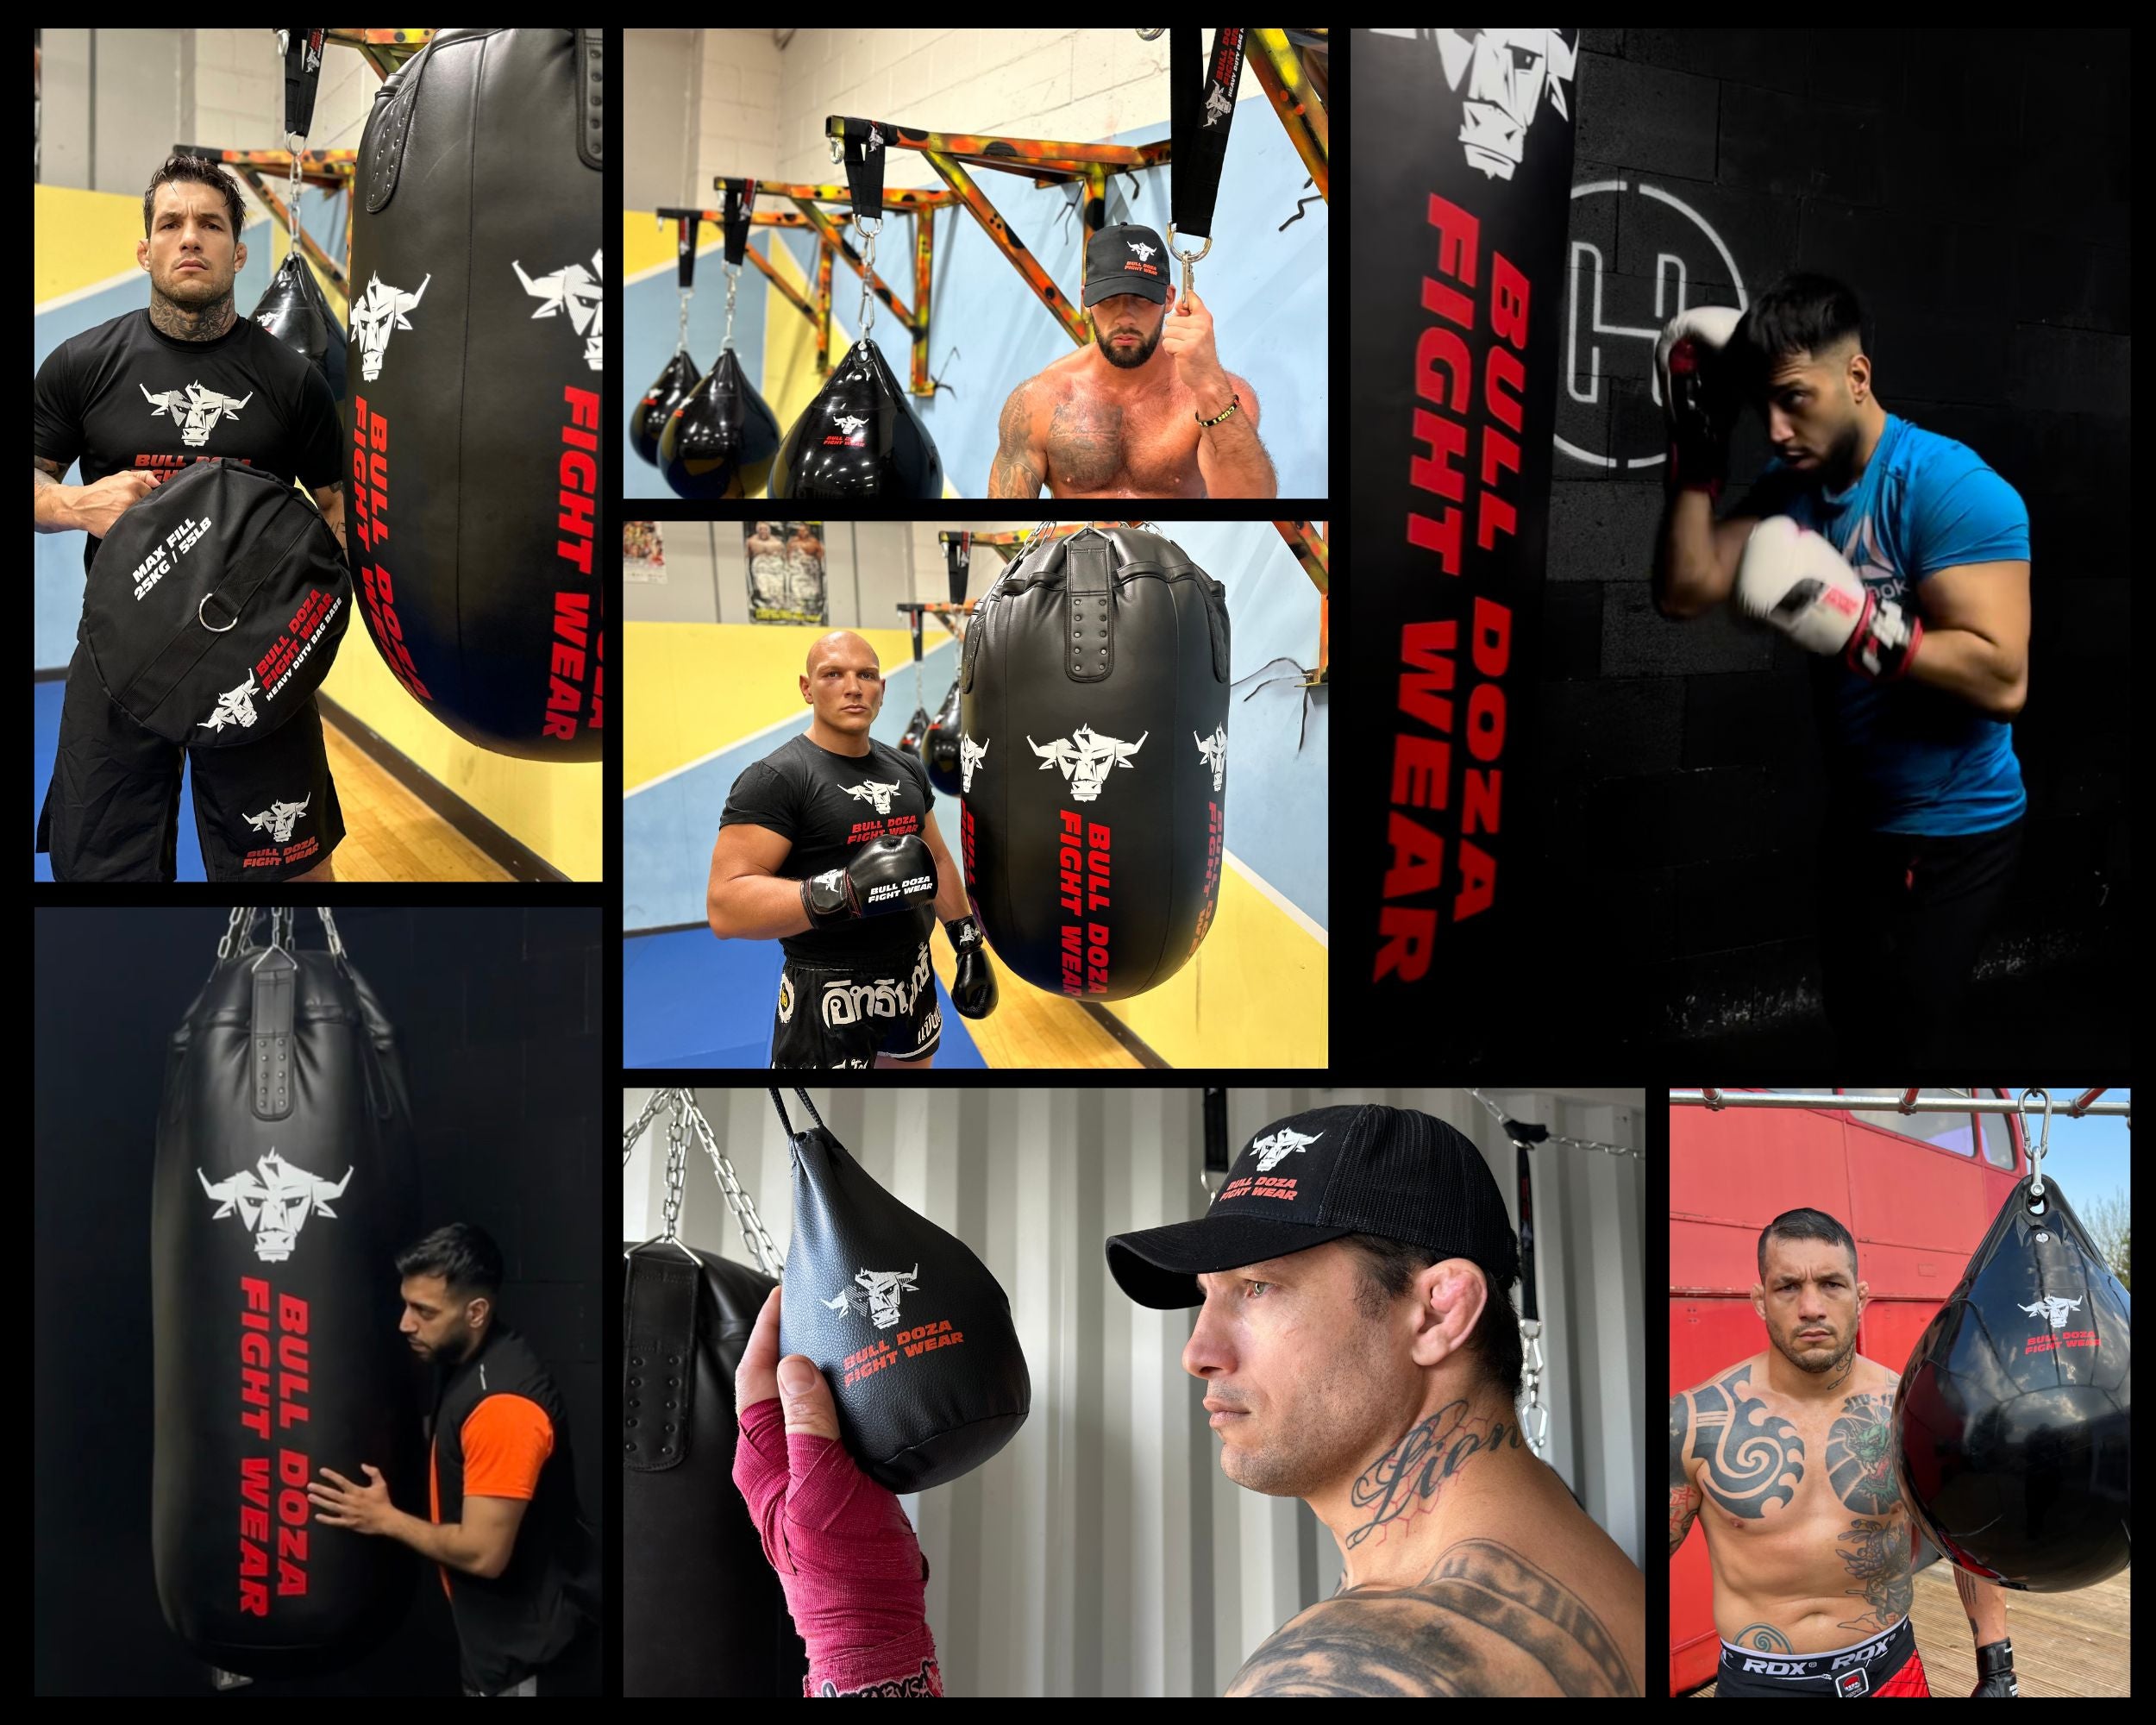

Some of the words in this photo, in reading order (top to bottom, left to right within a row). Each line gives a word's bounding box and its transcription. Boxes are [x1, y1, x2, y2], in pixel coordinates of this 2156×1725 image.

[1228, 72, 1237, 97] HEAVY
[1406, 192, 1480, 576] FIGHT
[1476, 250, 1531, 552] BULL
[135, 455, 186, 467] BULL
[354, 395, 370, 553] FIGHT
[370, 412, 388, 545] BULL
[557, 386, 599, 574] FIGHT
[132, 545, 166, 583] MAX
[166, 518, 196, 549] FILL
[134, 559, 171, 601] 25KG
[179, 517, 212, 555] 55LB
[255, 635, 290, 677] BULL
[288, 589, 322, 635] DOZA
[261, 639, 300, 691] FIGHT
[299, 593, 334, 640] WEAR
[266, 668, 292, 701] HEAVY
[292, 643, 311, 669] DUTY
[310, 622, 326, 644] BAG
[324, 597, 342, 624] BASE
[375, 563, 433, 700] DOZA
[542, 592, 590, 740] WEAR
[1372, 620, 1457, 983] WEAR
[1452, 597, 1513, 922] DOZA
[243, 857, 282, 868] FIGHT
[285, 843, 319, 864] WEAR
[247, 849, 279, 857] BULL
[283, 836, 316, 856] DOZA
[847, 829, 885, 844] FIGHT
[889, 825, 918, 836] WEAR
[852, 820, 882, 833] BULL
[887, 815, 917, 827] DOZA
[1060, 809, 1082, 916] FIGHT
[1087, 823, 1110, 911] BULL
[1203, 800, 1217, 898] FIGHT
[868, 889, 901, 903] FIGHT
[904, 883, 932, 894] WEAR
[870, 883, 898, 895] BULL
[902, 875, 931, 888] DOZA
[1062, 925, 1082, 997] WEAR
[1087, 922, 1109, 994] DOZA
[1219, 1187, 1251, 1201] FIGHT
[1251, 1187, 1298, 1201] WEAR
[1226, 1177, 1252, 1191] BULL
[1255, 1176, 1298, 1188] DOZA
[240, 1276, 271, 1440] FIGHT
[278, 1293, 310, 1429] BULL
[843, 1340, 890, 1371] BULL
[897, 1320, 953, 1346] DOZA
[844, 1351, 898, 1390] FIGHT
[904, 1332, 964, 1358] WEAR
[2024, 1341, 2062, 1356] FIGHT
[2066, 1339, 2102, 1347] WEAR
[2028, 1334, 2058, 1346] BULL
[239, 1457, 271, 1618] WEAR
[277, 1449, 310, 1597] DOZA
[1743, 1658, 1808, 1675] RDX
